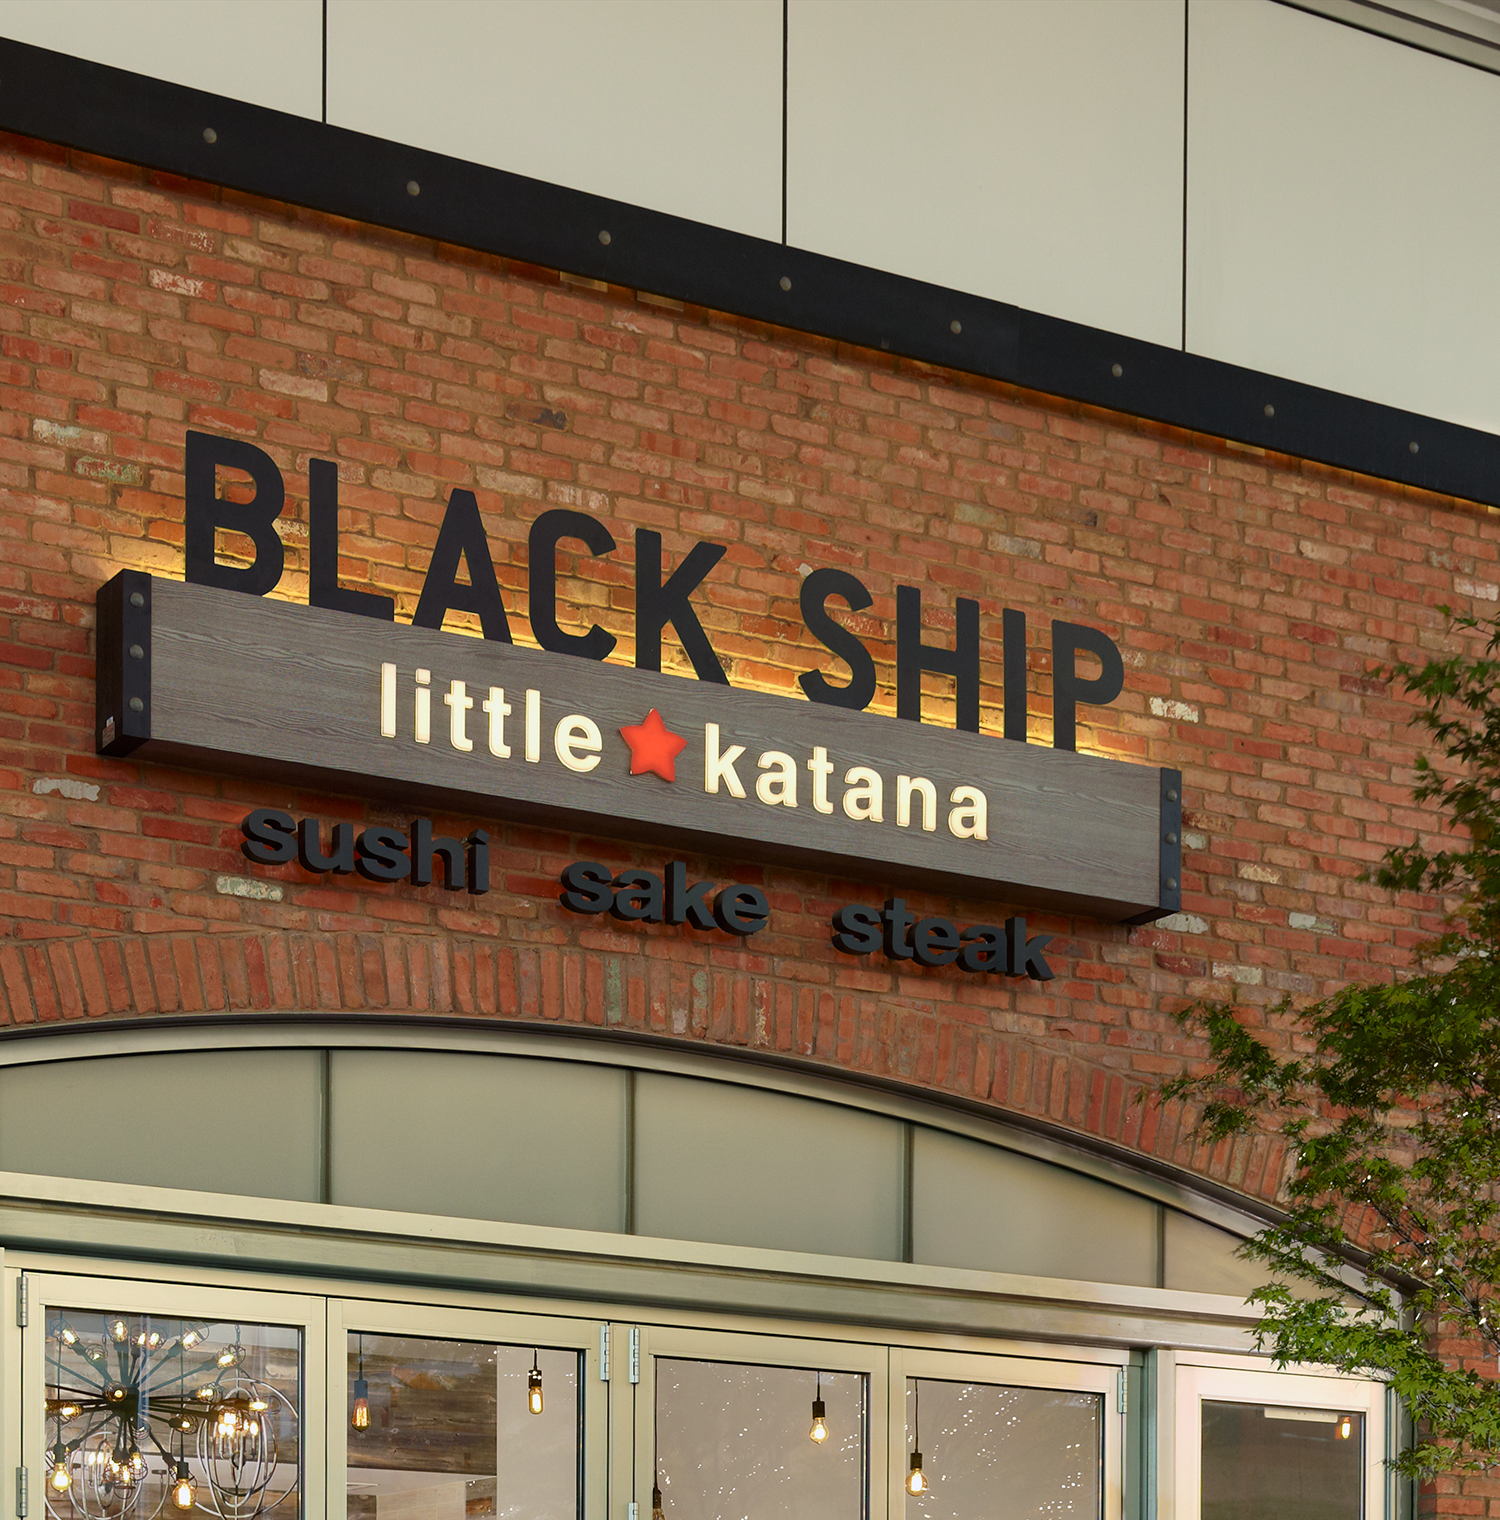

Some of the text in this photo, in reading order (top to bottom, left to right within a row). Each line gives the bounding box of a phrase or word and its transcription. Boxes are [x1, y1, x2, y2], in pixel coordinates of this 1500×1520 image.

[185, 430, 1125, 751] BLACK SHIP
[380, 661, 988, 841] little katana
[240, 808, 1056, 982] sushi sake steak
